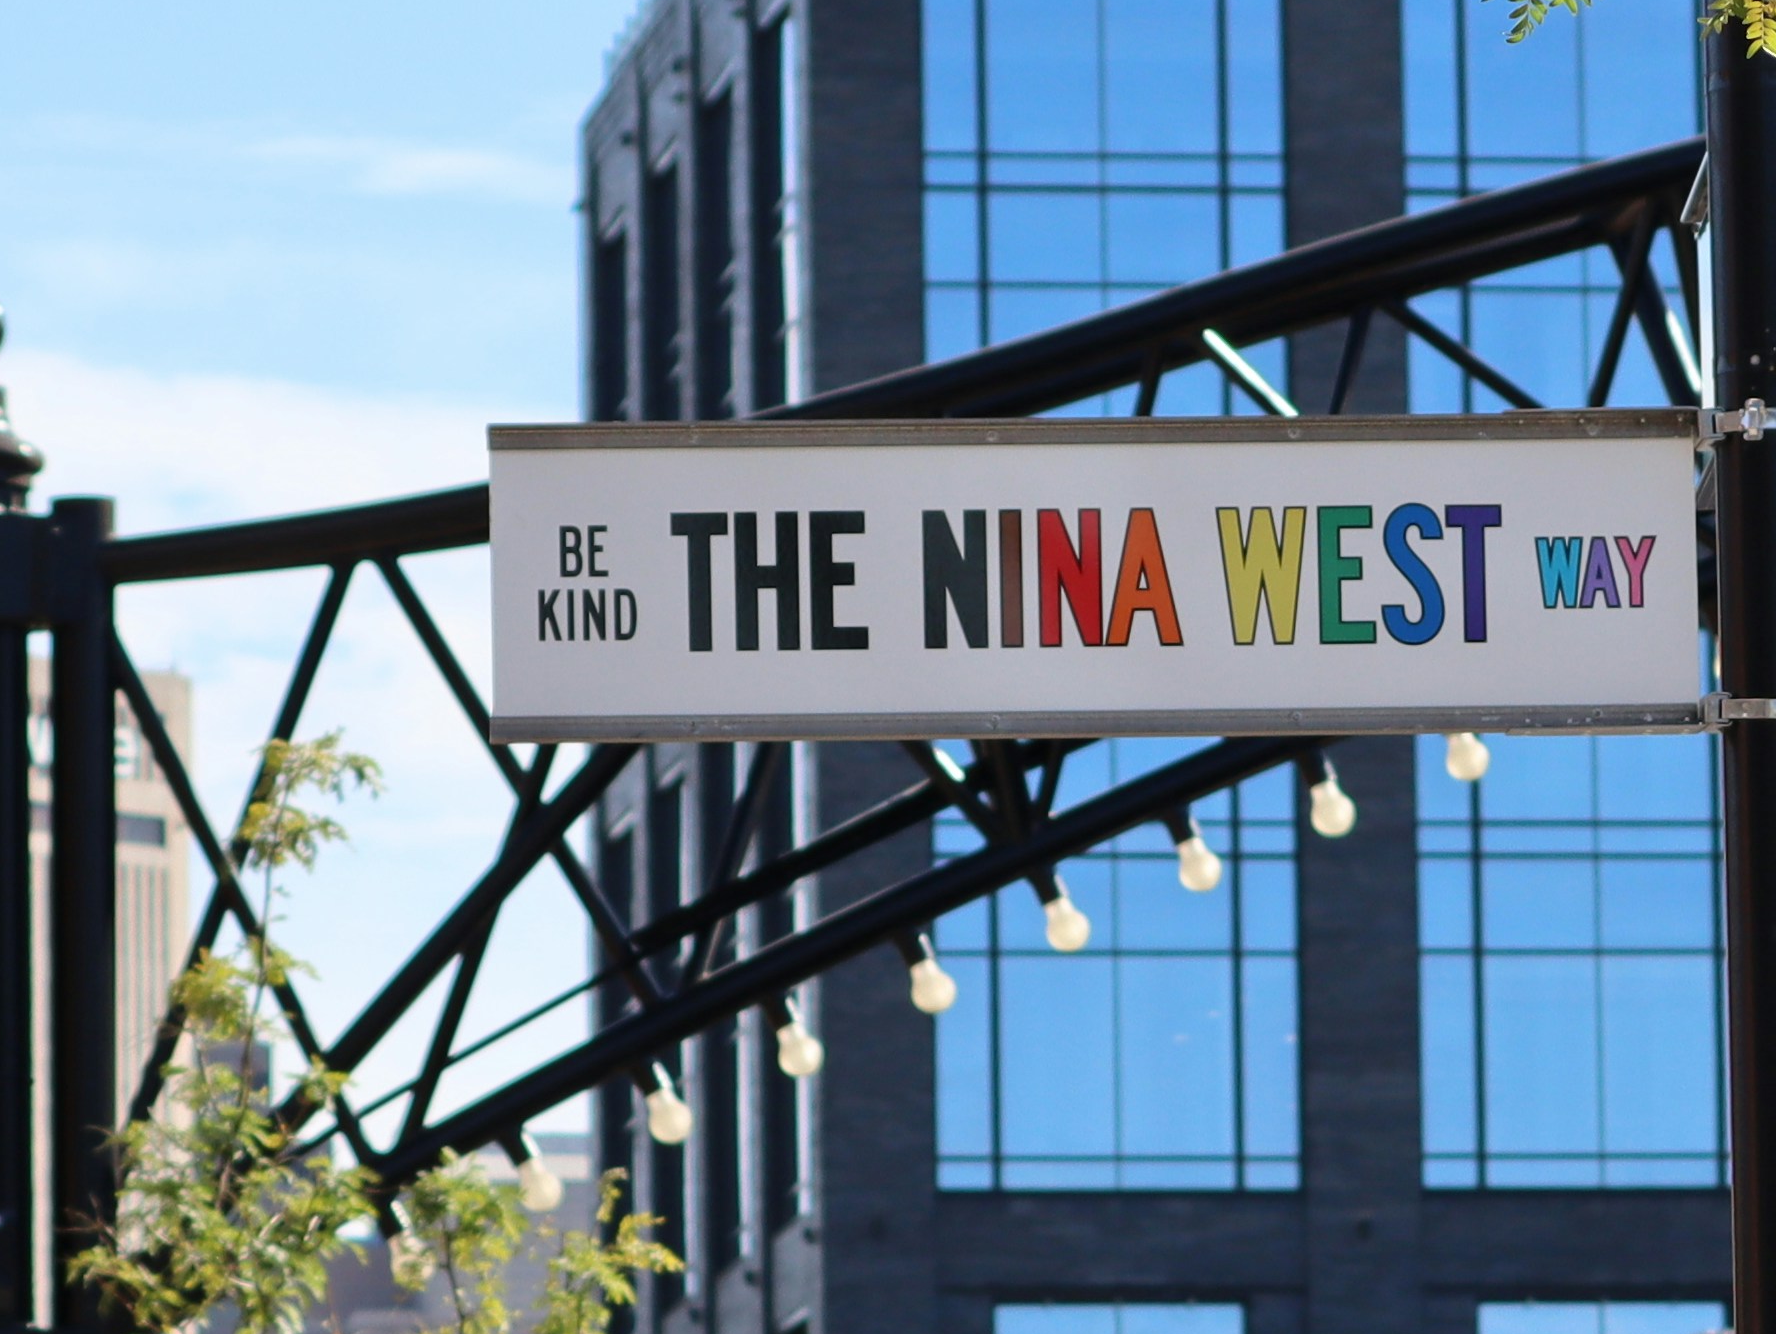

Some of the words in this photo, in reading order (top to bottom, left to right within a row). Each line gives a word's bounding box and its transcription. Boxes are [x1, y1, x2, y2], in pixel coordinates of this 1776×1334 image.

[559, 524, 610, 578] BE
[670, 509, 870, 652] THE
[922, 507, 1184, 648] NINA
[1215, 503, 1502, 645] WEST
[1534, 534, 1657, 609] WAY
[537, 588, 638, 642] KIND
